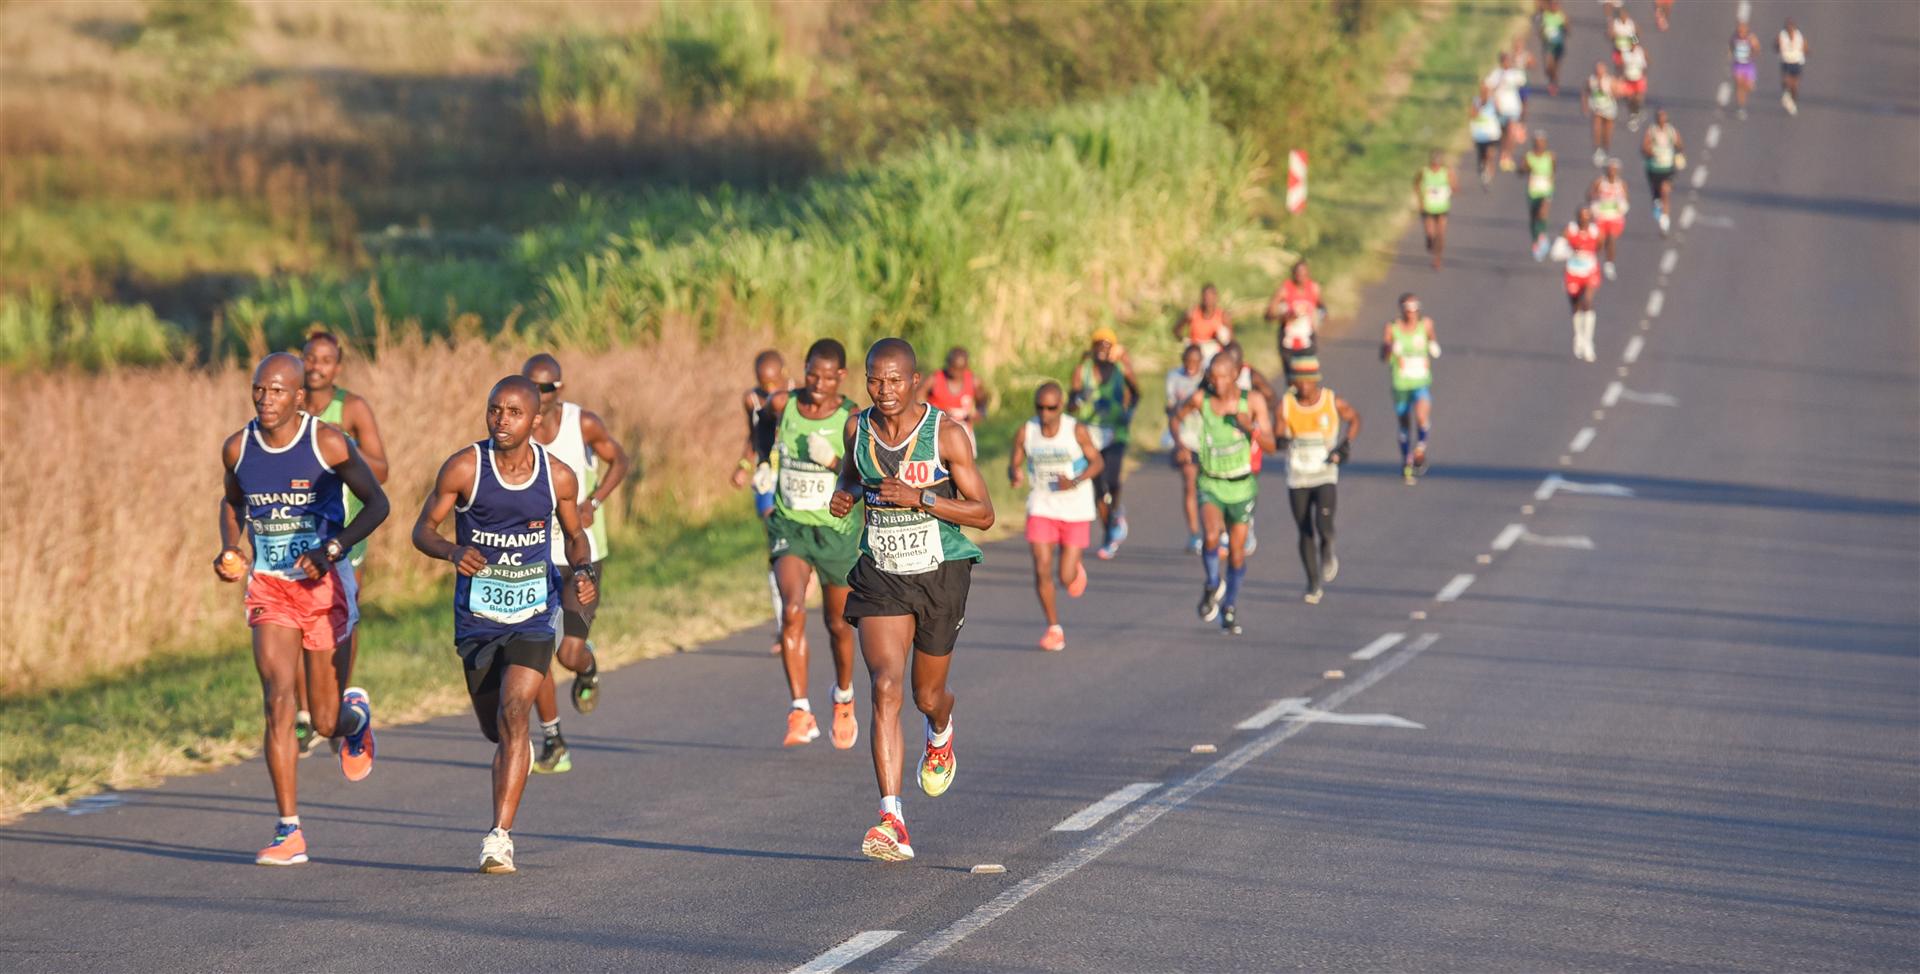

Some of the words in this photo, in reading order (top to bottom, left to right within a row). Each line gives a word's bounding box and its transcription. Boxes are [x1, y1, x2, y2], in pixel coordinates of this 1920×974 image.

[904, 462, 928, 483] 40
[270, 506, 292, 520] AC
[882, 512, 931, 524] NEDBAN
[471, 529, 546, 548] ZITHANDE
[877, 530, 928, 552] 38127
[263, 540, 310, 562] 35768
[883, 548, 928, 560] Madimetsa
[498, 552, 522, 566] AC
[930, 555, 940, 566] A
[493, 566, 544, 579] NEDBANK
[481, 586, 536, 606] 33616
